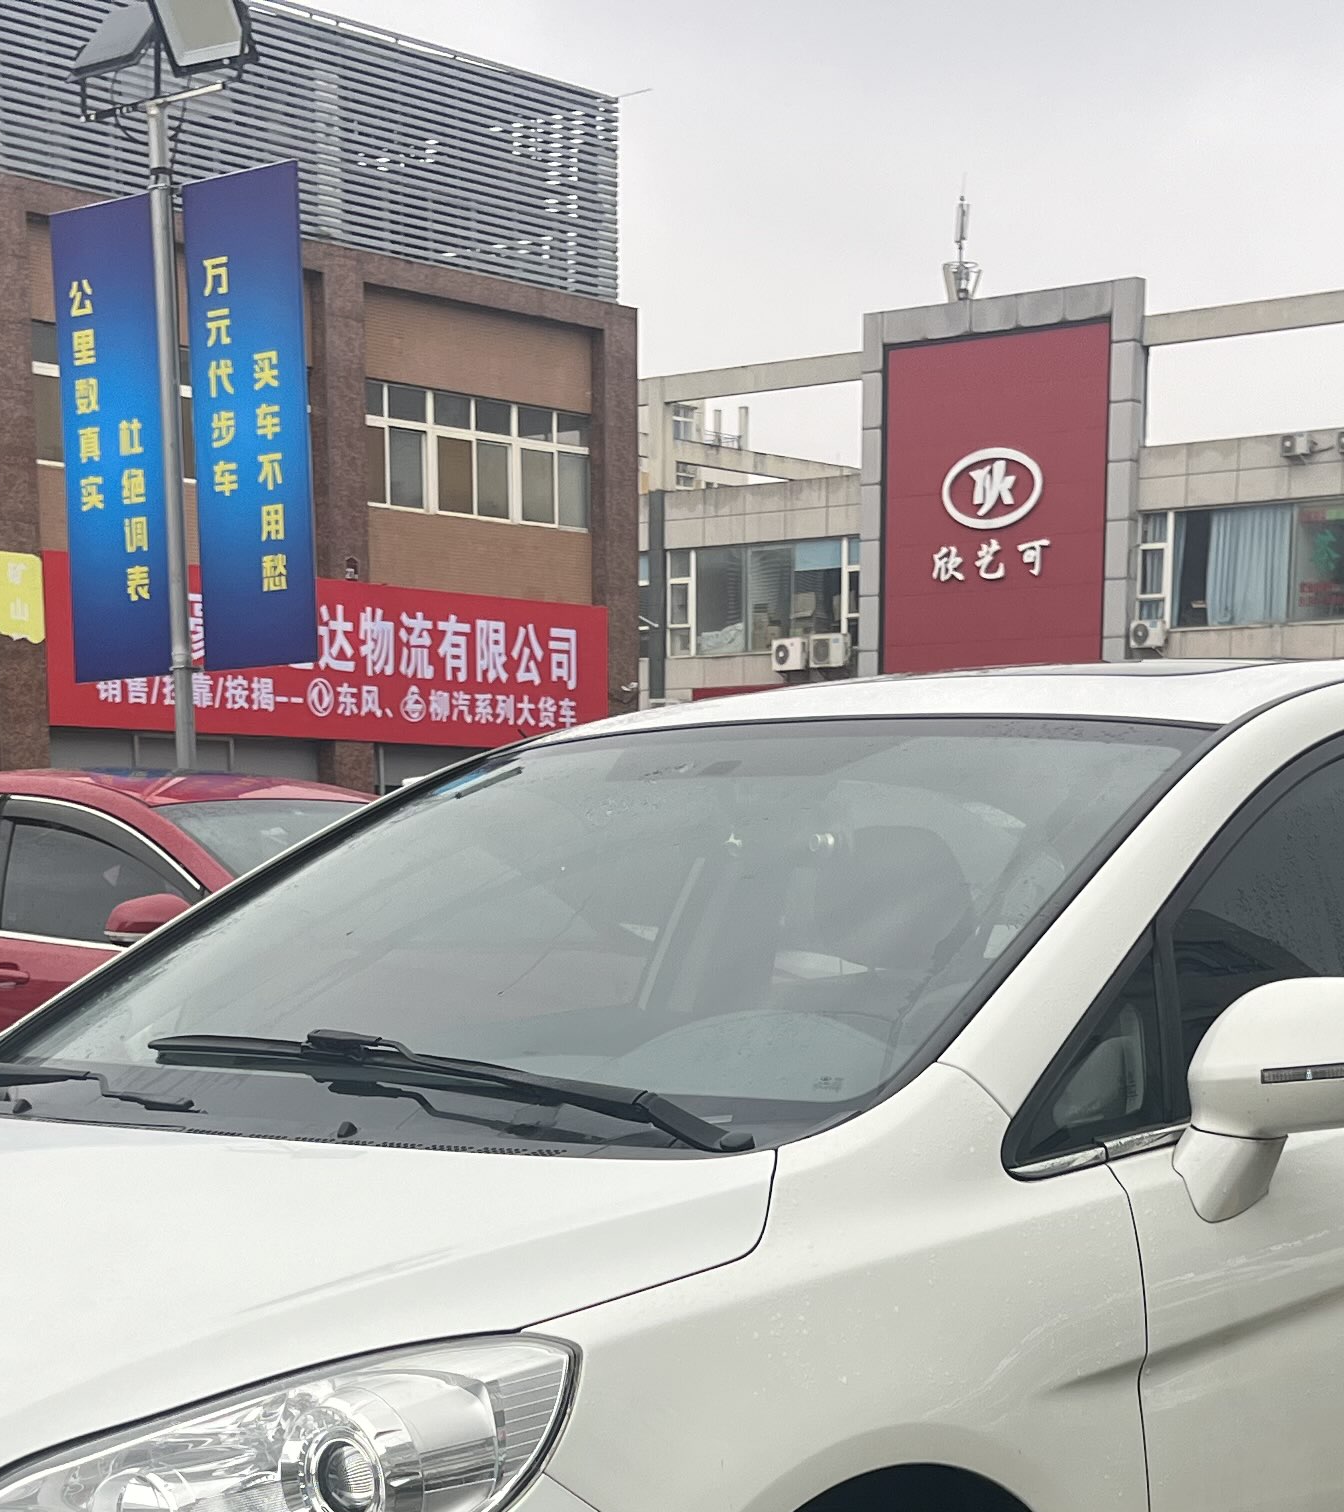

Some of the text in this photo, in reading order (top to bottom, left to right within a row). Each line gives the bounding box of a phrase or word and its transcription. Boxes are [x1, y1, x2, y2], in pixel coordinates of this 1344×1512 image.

[69, 279, 105, 512] 公里数真实
[203, 256, 238, 496] 万元代步车
[119, 418, 151, 602] 杜绝调表
[253, 350, 288, 593] 买车不用愁
[932, 538, 1051, 582] 欣艺可
[289, 604, 578, 691] 达物流有限公司
[429, 688, 578, 728] 柳汽系列大货车
